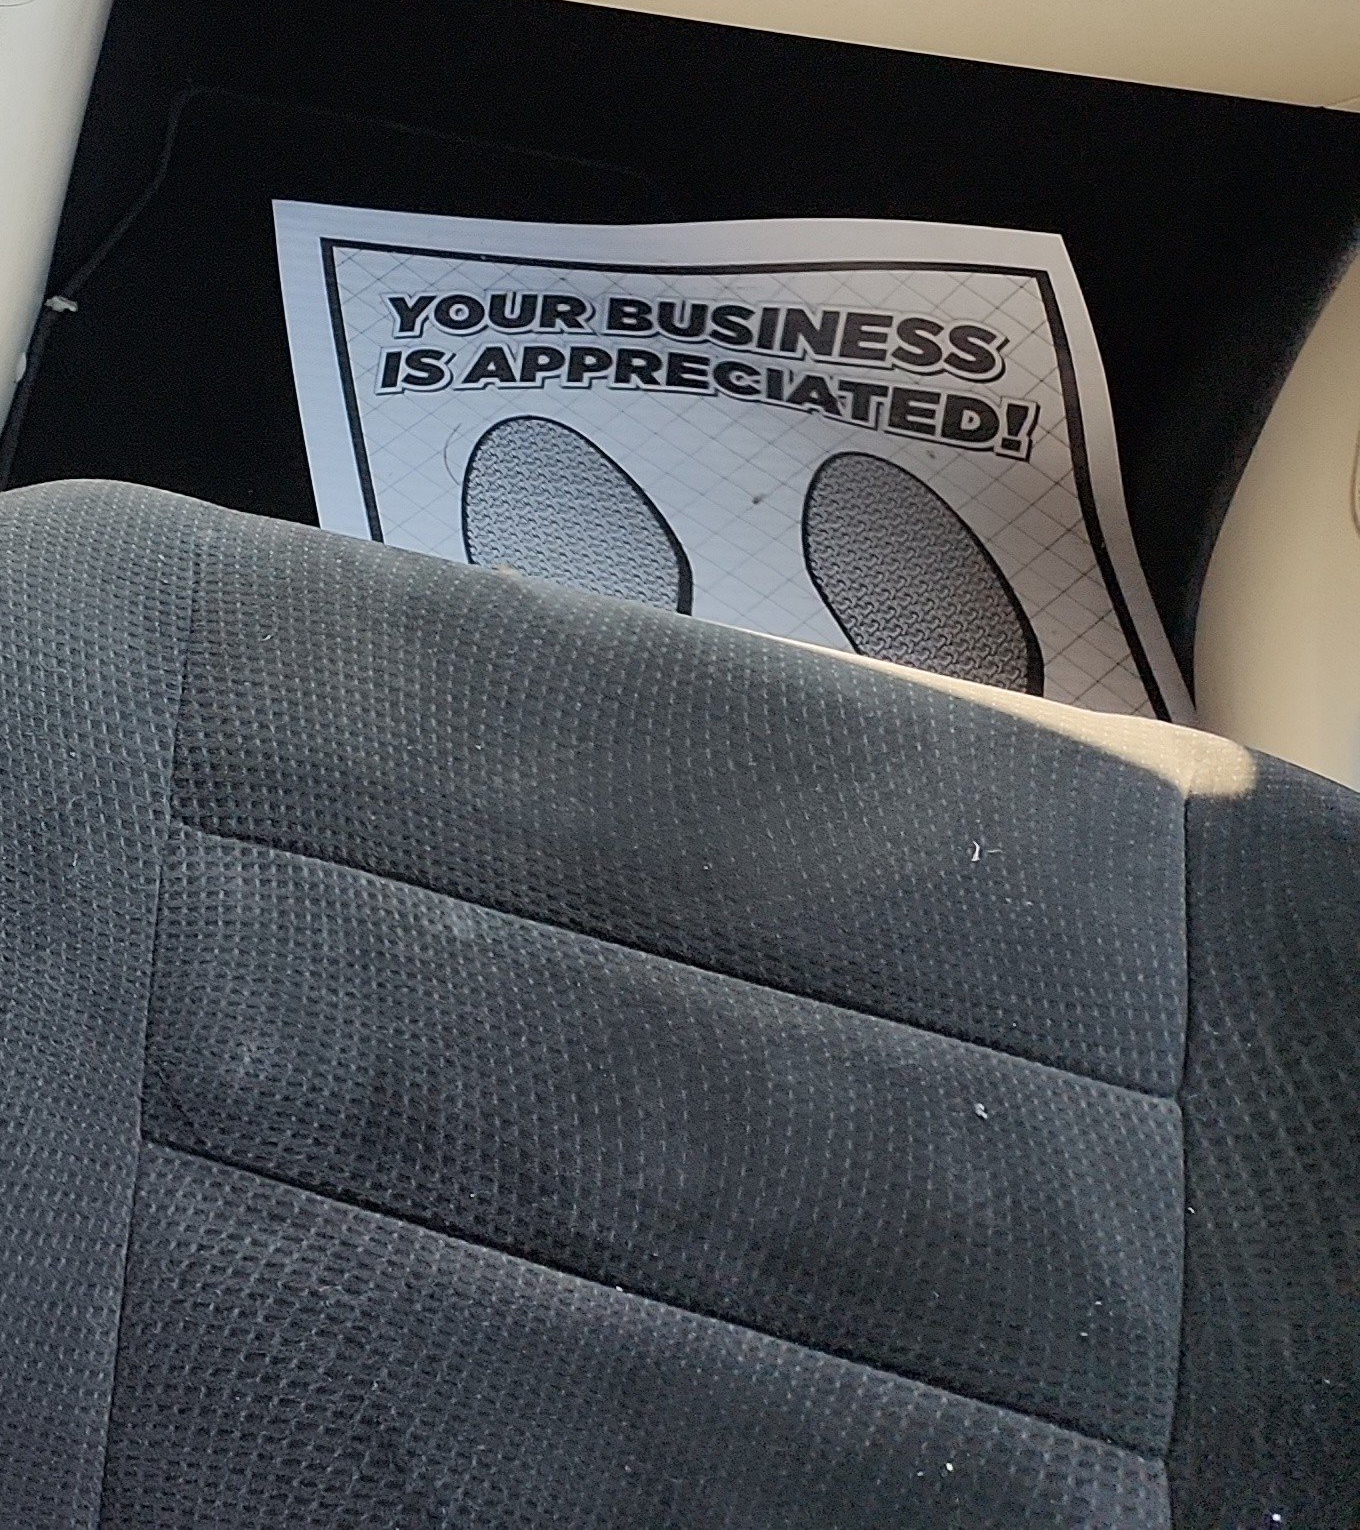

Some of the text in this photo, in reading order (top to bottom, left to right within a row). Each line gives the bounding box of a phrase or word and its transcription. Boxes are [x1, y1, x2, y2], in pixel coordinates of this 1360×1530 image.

[387, 291, 1010, 379] YOUR BUSINESS
[379, 346, 1040, 456] IS APPRECIATED!
